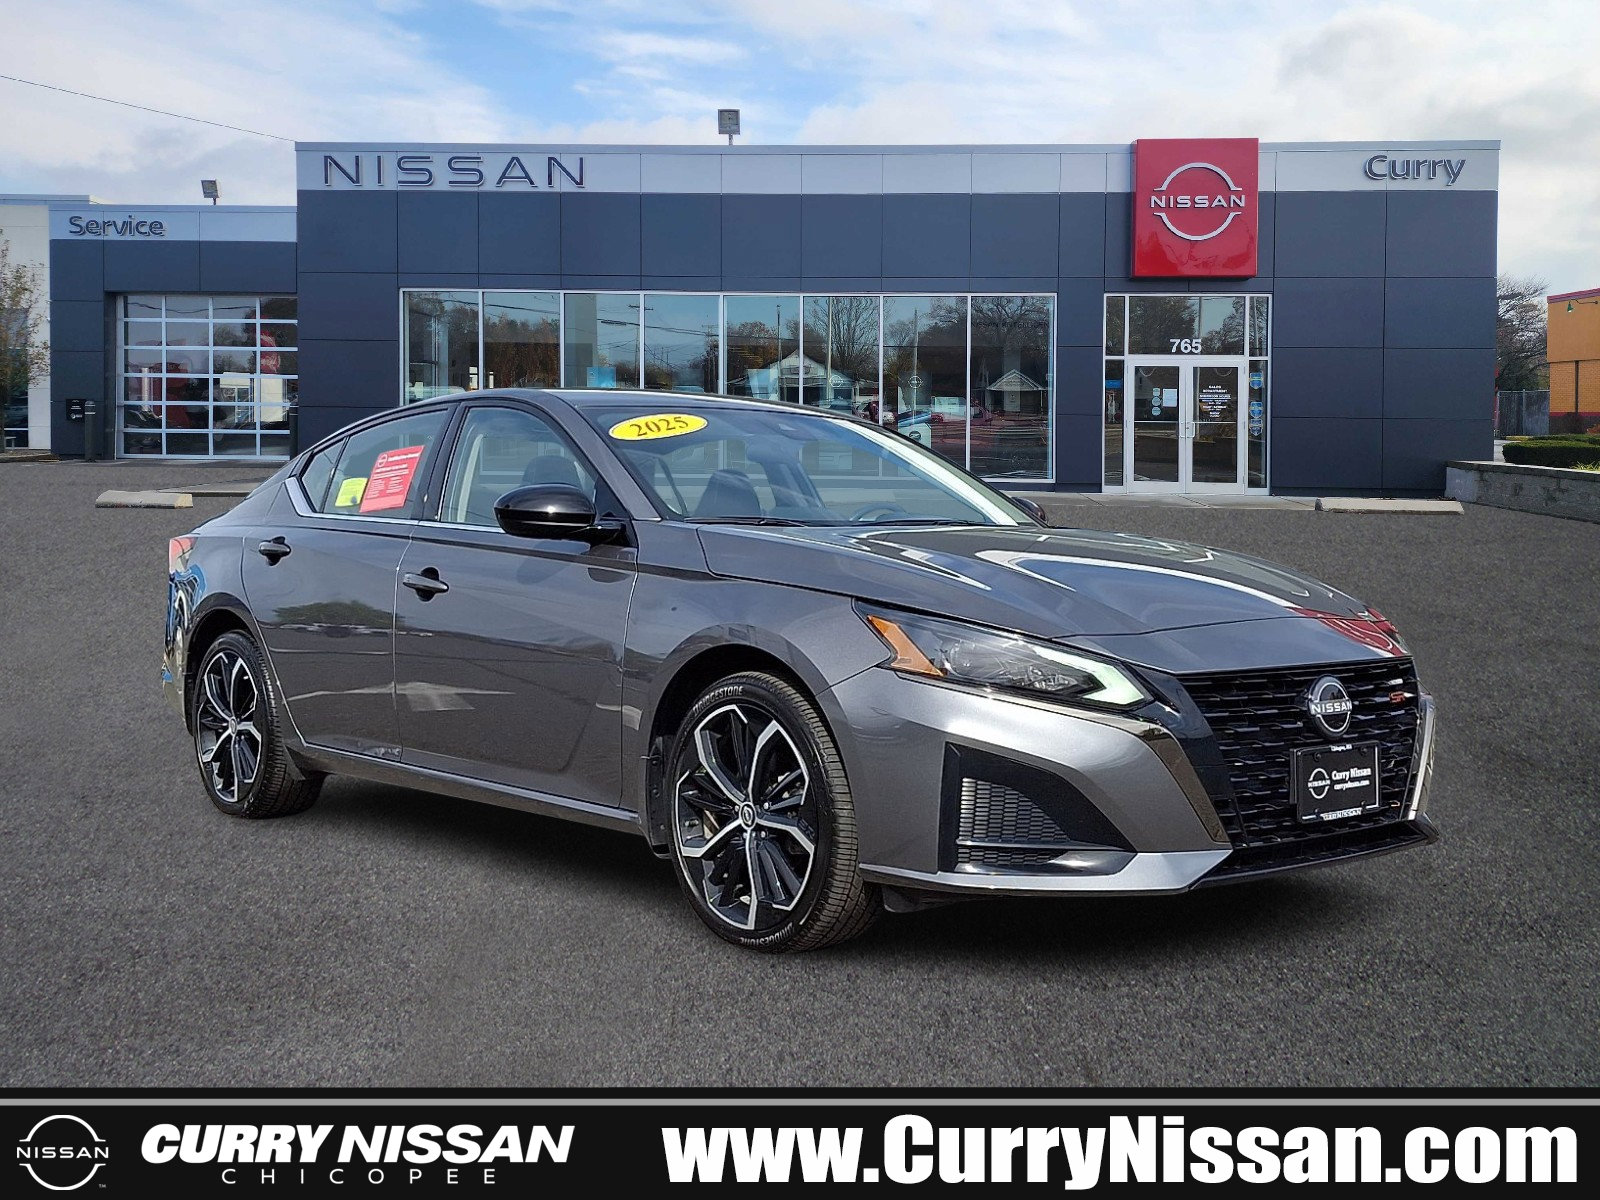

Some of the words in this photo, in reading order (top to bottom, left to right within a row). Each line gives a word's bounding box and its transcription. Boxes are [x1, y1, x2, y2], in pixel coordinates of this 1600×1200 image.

[323, 155, 586, 188] NISSAN
[1364, 154, 1467, 187] Curry
[1150, 194, 1246, 209] NISSAN
[69, 214, 166, 237] Service
[1169, 338, 1202, 354] 765
[629, 416, 689, 437] 2025
[1310, 701, 1352, 716] NISSAN
[1331, 770, 1351, 781] Curry
[1350, 767, 1372, 779] Nissan
